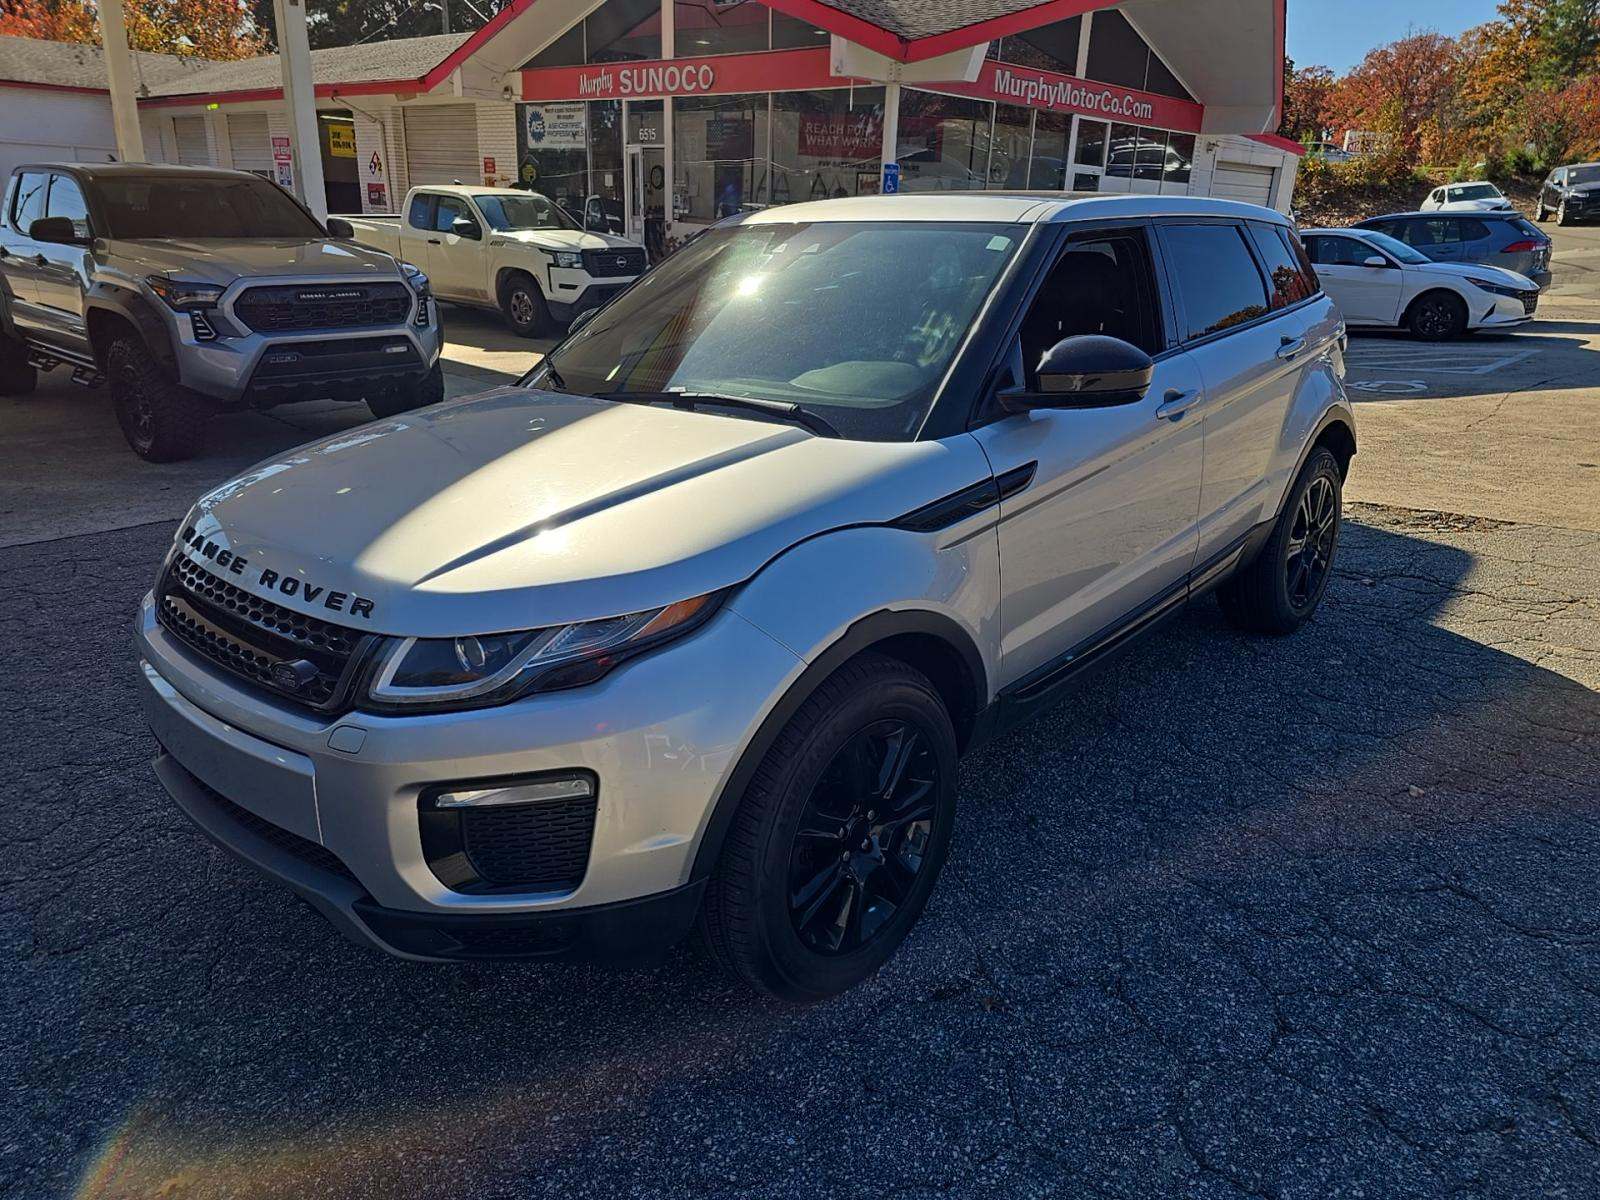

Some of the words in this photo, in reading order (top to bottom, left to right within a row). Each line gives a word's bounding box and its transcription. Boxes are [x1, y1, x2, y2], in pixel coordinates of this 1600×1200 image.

[580, 68, 613, 97] Murphy
[619, 65, 714, 94] SUNOCO
[994, 69, 1153, 119] MurphyMotorCo.Com
[639, 128, 657, 141] 6515
[805, 122, 844, 135] REACH
[805, 134, 839, 147] WHAT
[182, 525, 248, 576] RANGE
[258, 568, 375, 620] ROVER
